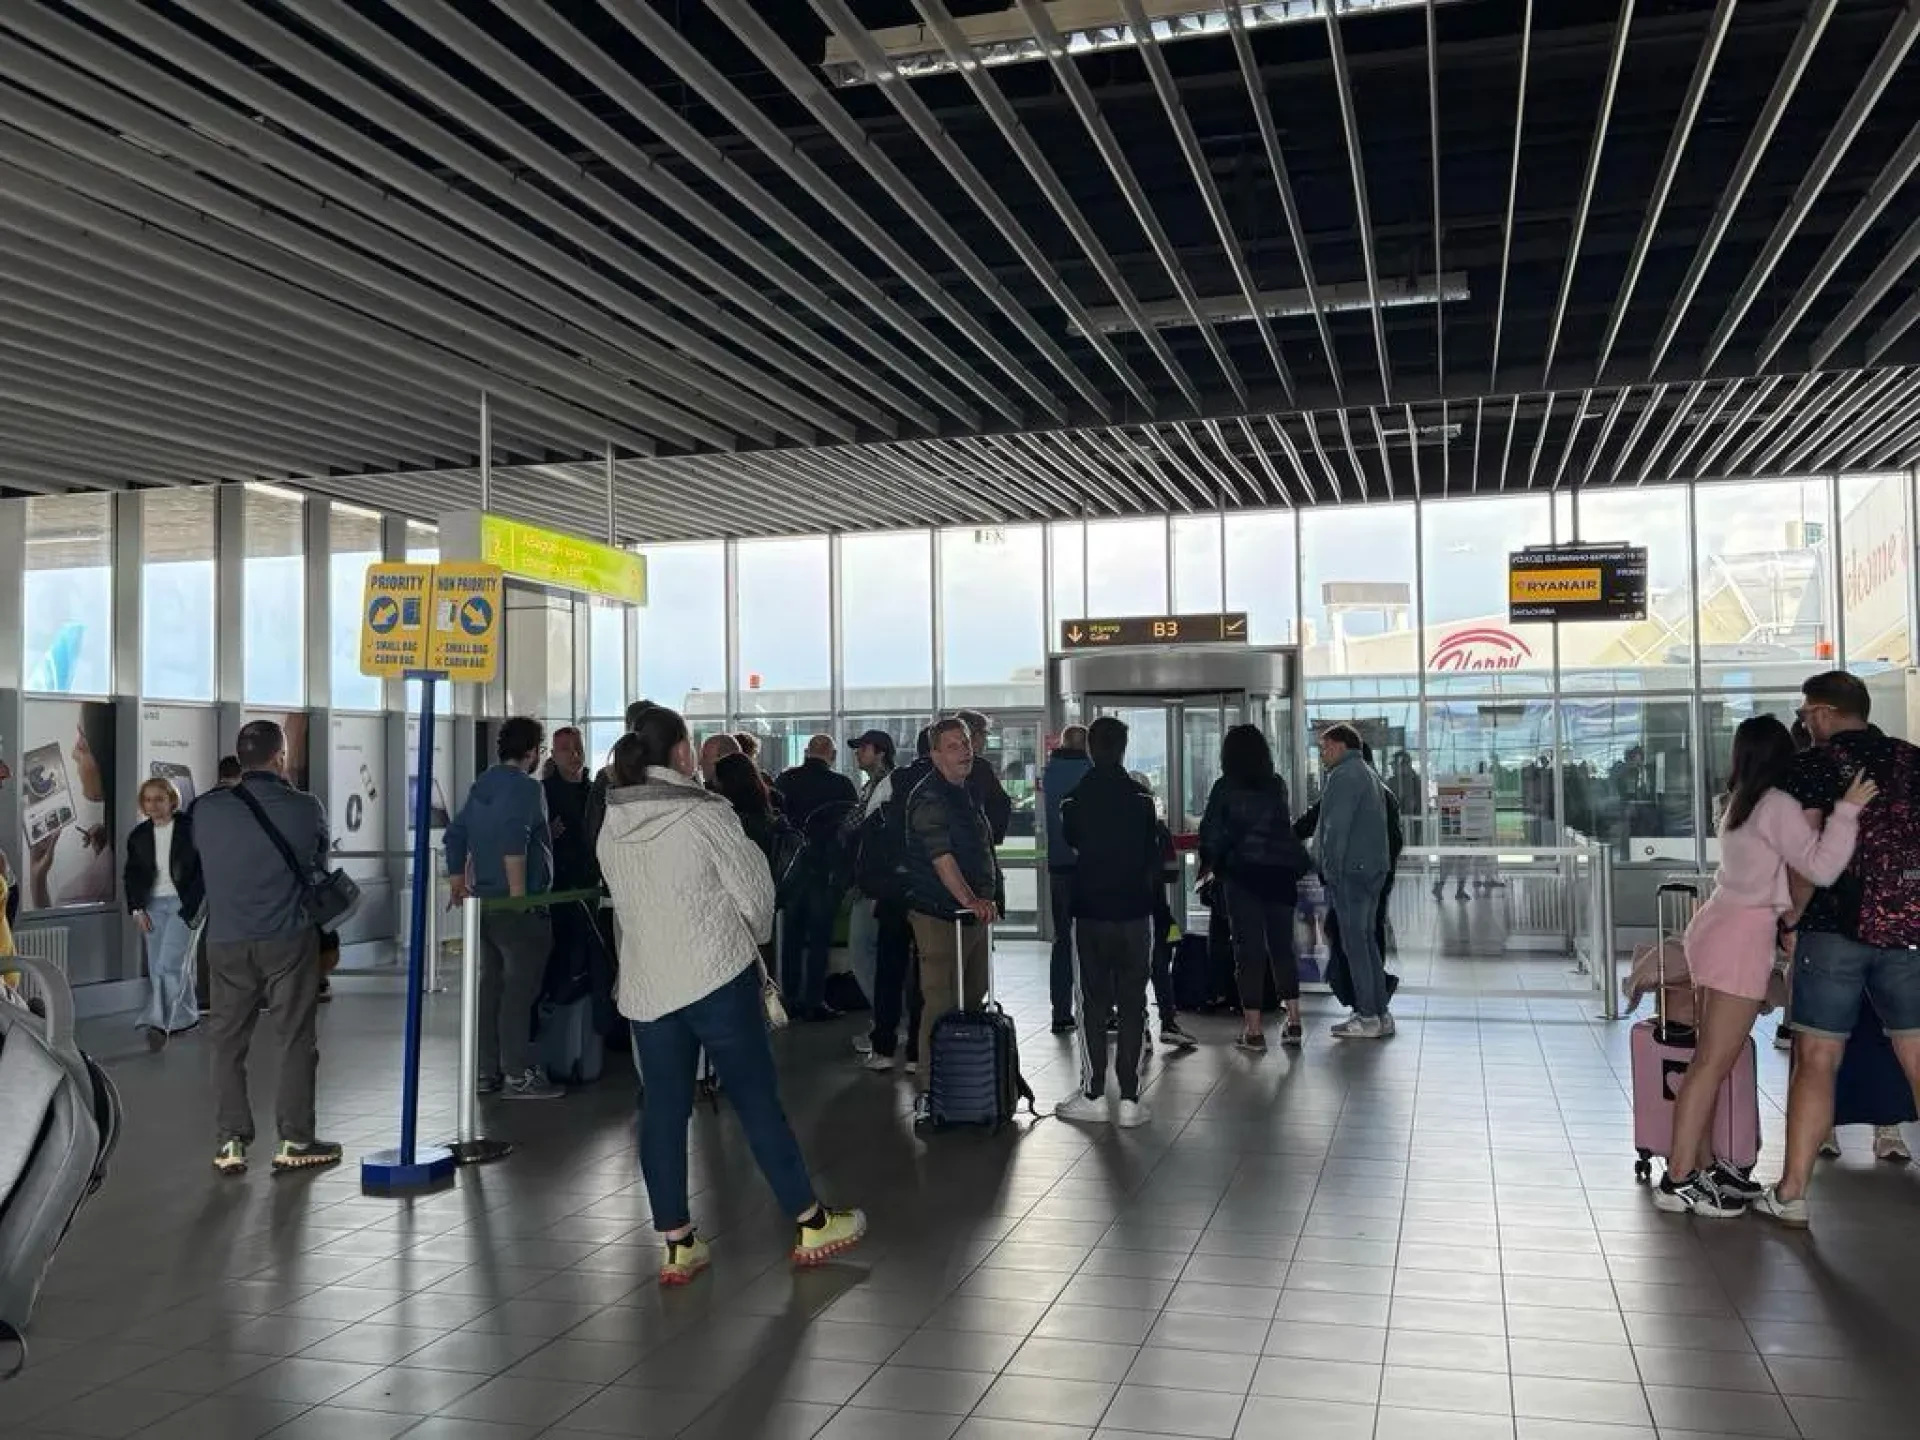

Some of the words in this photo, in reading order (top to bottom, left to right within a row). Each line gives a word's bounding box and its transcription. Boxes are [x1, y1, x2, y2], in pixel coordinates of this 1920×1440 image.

[370, 575, 425, 591] PRIORITY
[438, 576, 455, 591] NON
[457, 576, 497, 592] PRIORITY
[1527, 579, 1597, 592] RYANAIR
[1154, 621, 1179, 638] B3
[376, 640, 400, 651] SMALL
[402, 641, 418, 652] BAG
[445, 643, 471, 653] SMALL
[472, 644, 488, 654] BAG
[375, 653, 398, 665] CABIN
[400, 654, 416, 665] BAG
[444, 656, 468, 668] CABIN
[470, 657, 486, 668] BAG
